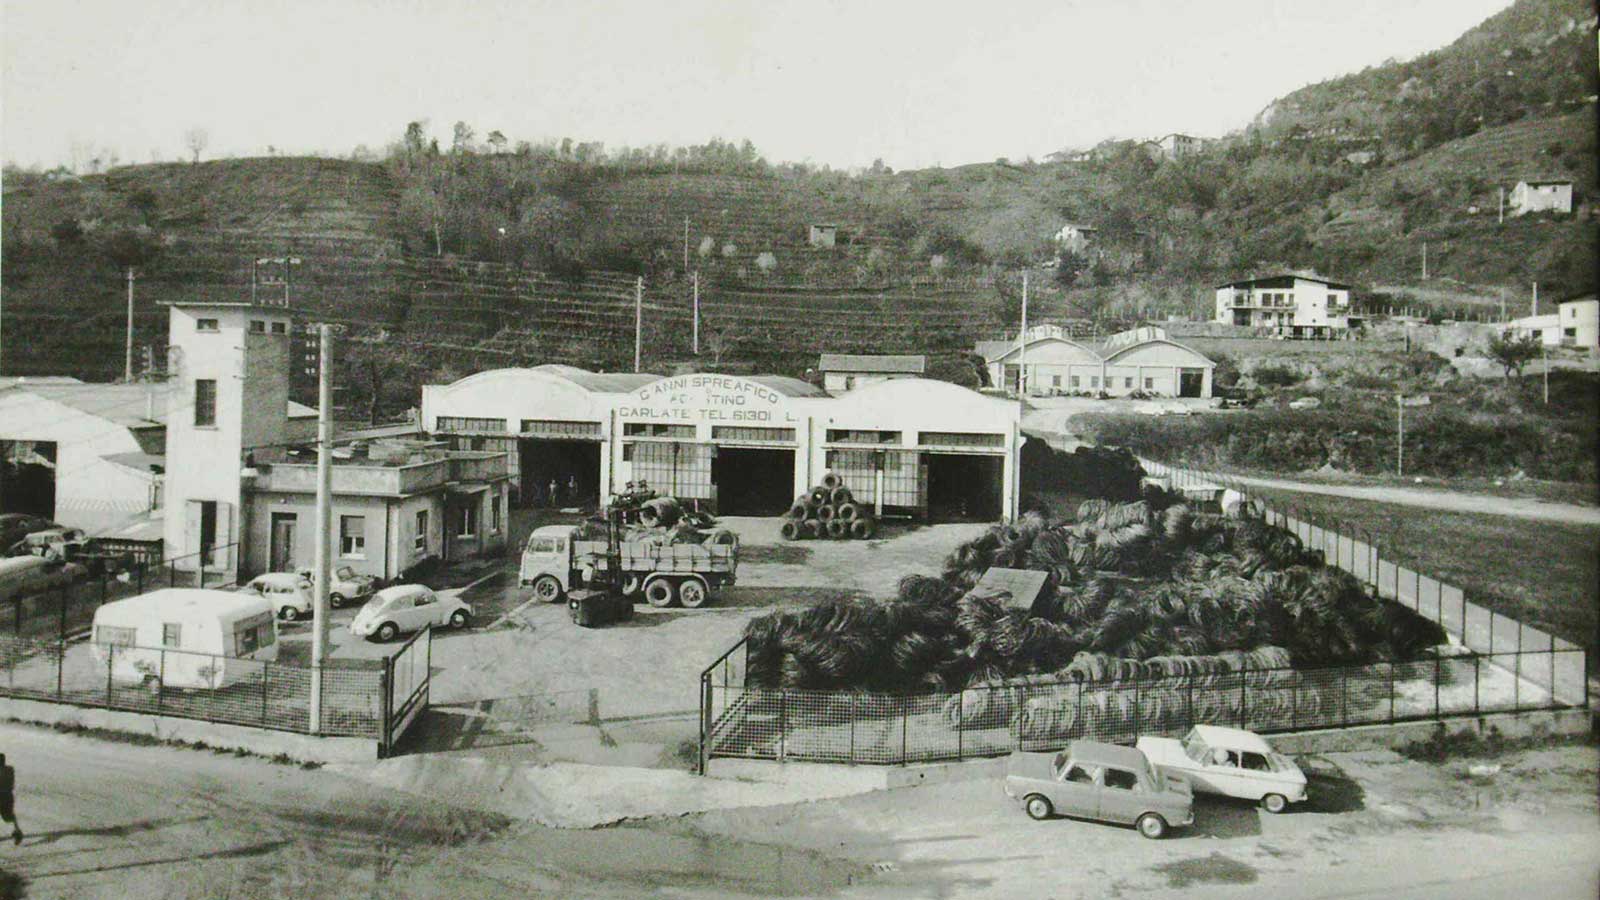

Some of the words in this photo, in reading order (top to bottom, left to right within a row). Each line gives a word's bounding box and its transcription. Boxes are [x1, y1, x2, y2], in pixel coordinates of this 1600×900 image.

[639, 377, 688, 401] GANNI
[691, 376, 778, 404] SPREAFICO
[619, 407, 691, 419] GARLATE
[733, 410, 771, 421] 61301
